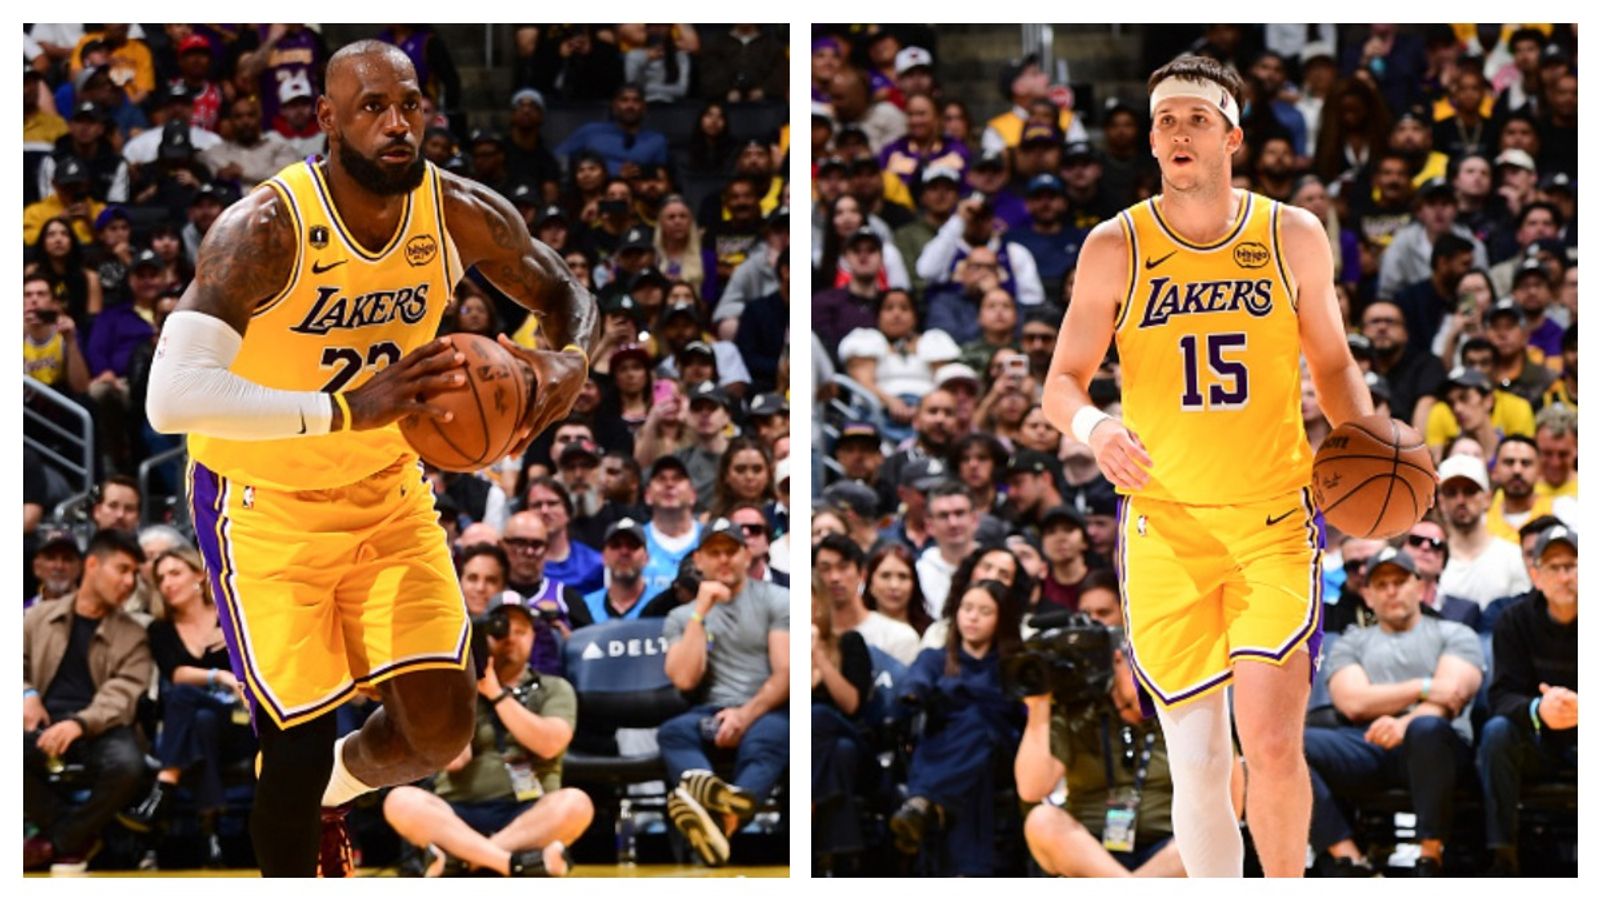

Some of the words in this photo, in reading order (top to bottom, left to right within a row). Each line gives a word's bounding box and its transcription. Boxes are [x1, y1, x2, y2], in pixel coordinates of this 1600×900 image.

[288, 284, 429, 335] LAKERS
[1138, 277, 1274, 329] LAKERS
[1180, 333, 1248, 408] 15
[608, 637, 668, 657] DELT
